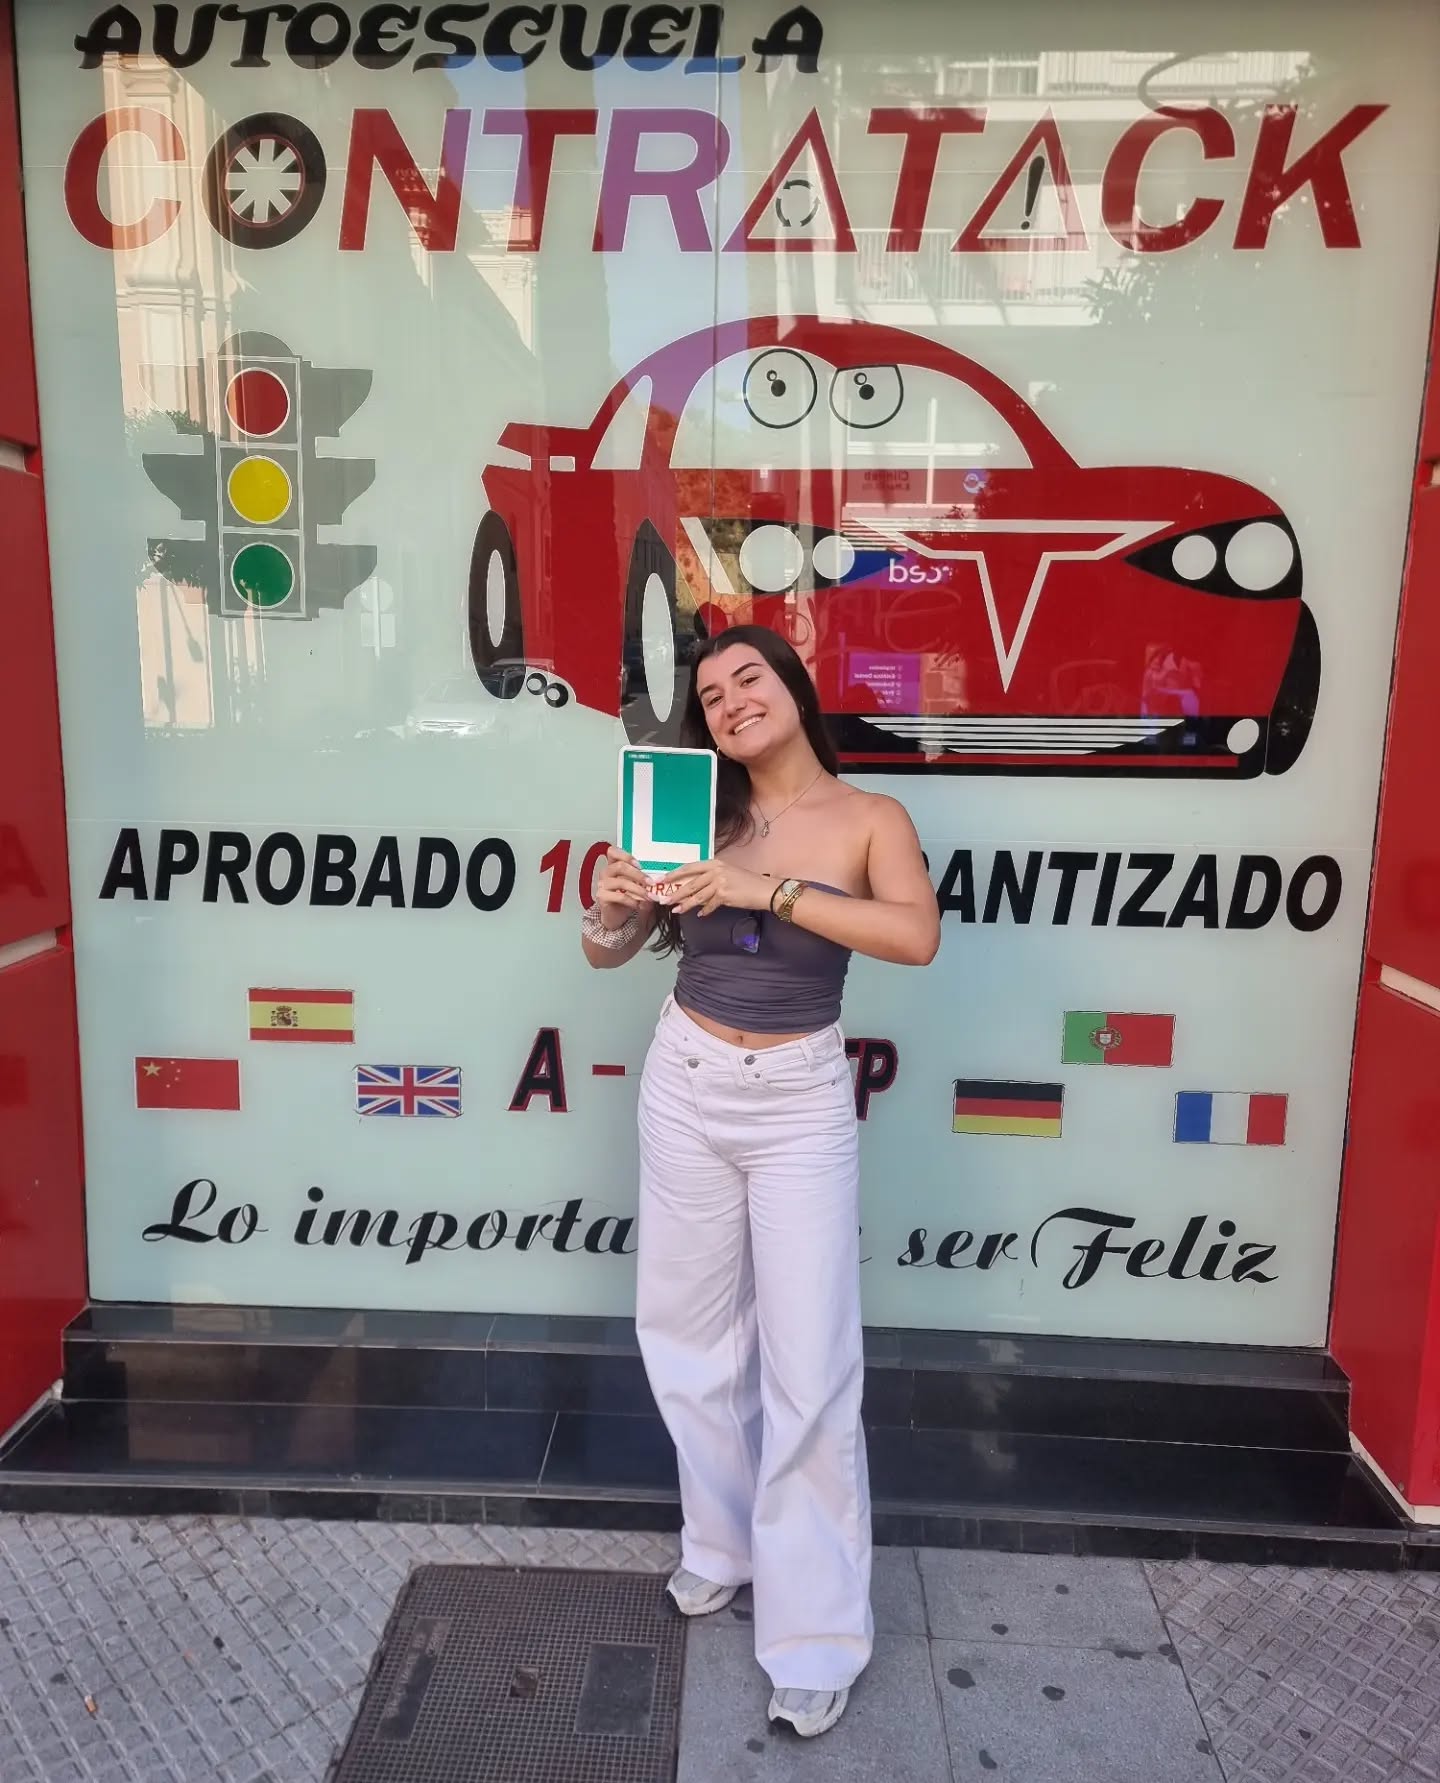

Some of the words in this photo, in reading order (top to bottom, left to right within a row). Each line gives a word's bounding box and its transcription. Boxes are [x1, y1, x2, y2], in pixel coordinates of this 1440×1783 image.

[74, 2, 823, 75] AUTOESCUELA
[64, 103, 1391, 253] CONTRATACK
[99, 827, 517, 912] APROBADO
[538, 839, 613, 913] 10
[921, 848, 1343, 932] ANTIZADO
[508, 1027, 569, 1113] A
[845, 1037, 899, 1121] P
[142, 1178, 269, 1244] Lo
[293, 1186, 638, 1265] importa
[897, 1228, 1018, 1270] ser
[1030, 1207, 1280, 1290] Feliz
